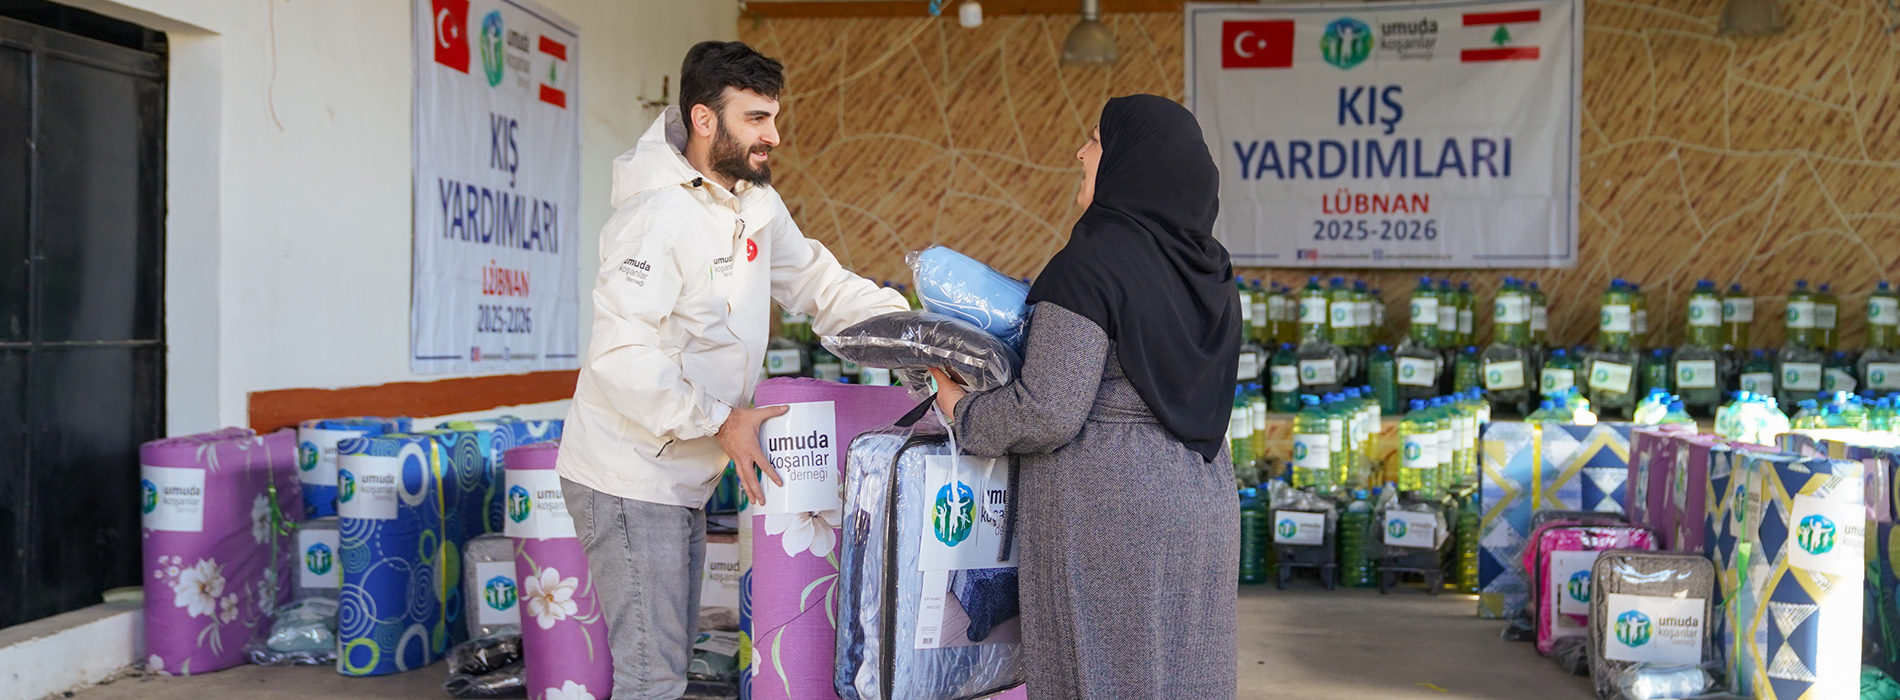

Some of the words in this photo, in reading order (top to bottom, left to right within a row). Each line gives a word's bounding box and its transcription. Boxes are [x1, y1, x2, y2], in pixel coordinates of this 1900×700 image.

[1338, 85, 1404, 135] KIŞ
[490, 111, 519, 188] KIŞ
[1233, 137, 1512, 179] YARDIMLARI
[1322, 188, 1430, 214] LÜBNAN
[438, 177, 559, 254] YARDIMLARI
[1313, 219, 1438, 241] 2025-2026
[623, 258, 651, 272] umuda
[482, 259, 531, 297] LÜBNAN
[477, 304, 532, 334] 2025-2026
[769, 430, 829, 452] umuda
[769, 450, 829, 472] koşanlar
[790, 467, 828, 482] derneği
[537, 490, 563, 500] umu
[537, 501, 567, 512] koşan
[710, 561, 740, 572] umud
[1658, 615, 1699, 627] umuda
